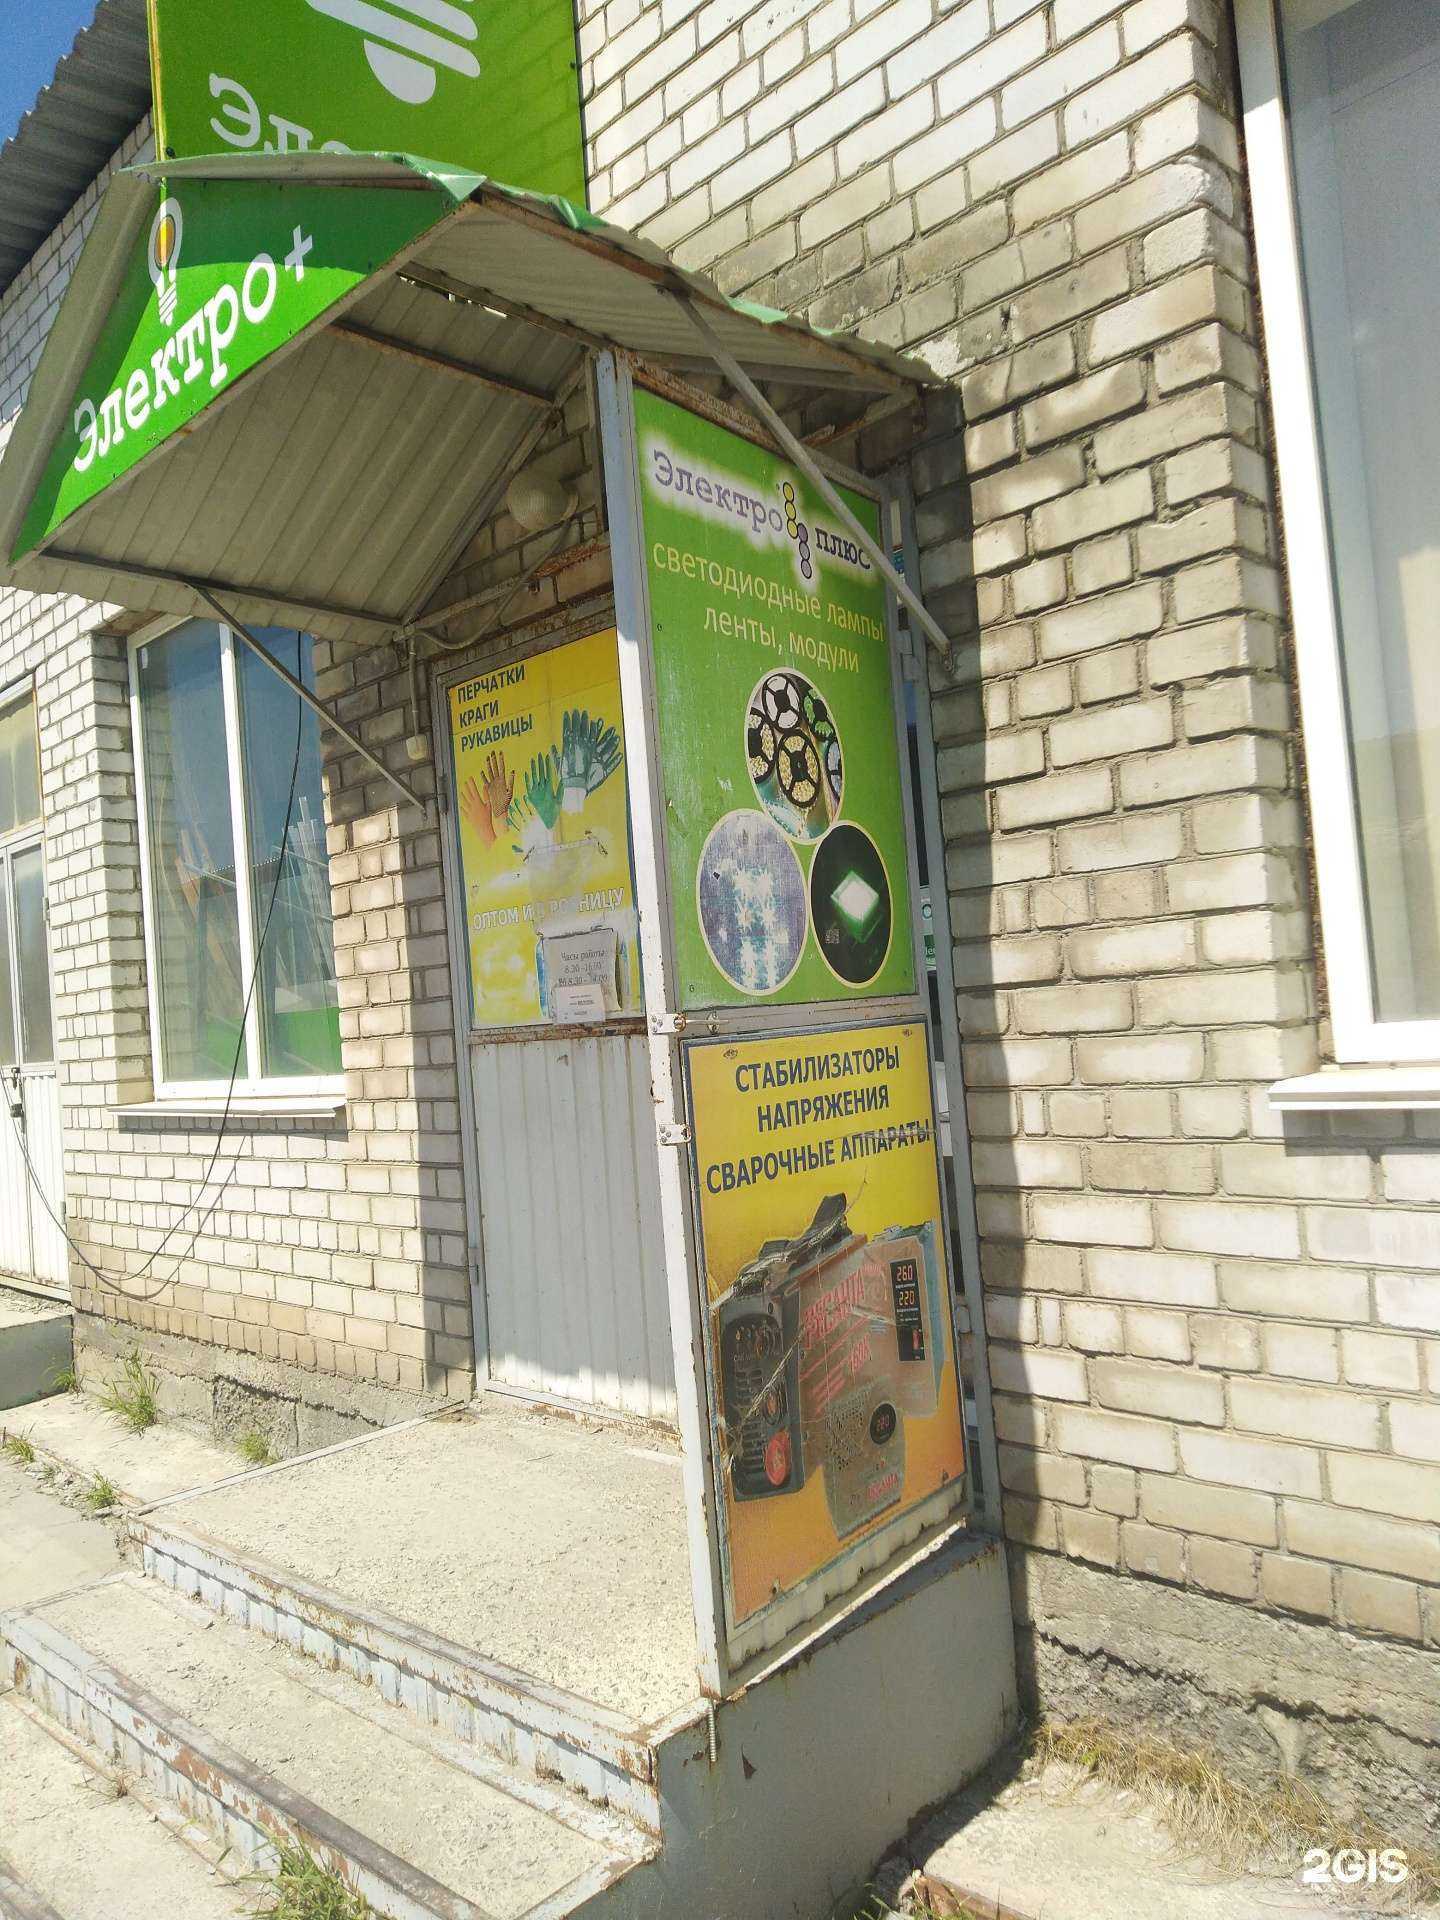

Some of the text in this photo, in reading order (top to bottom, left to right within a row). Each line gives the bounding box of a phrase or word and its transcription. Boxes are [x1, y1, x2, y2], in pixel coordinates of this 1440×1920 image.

[209, 73, 352, 154] Эл
[815, 527, 871, 570] плюс
[704, 608, 859, 673] ленты, модули
[457, 664, 526, 704] ПЕРЧАТКИ
[459, 700, 499, 728] КРАГИ
[461, 714, 533, 752] РУКАВИЦЫ
[472, 907, 519, 930] ОПТОМ
[736, 1045, 900, 1092] СТАБИЛИЗАТОРЫ
[757, 1085, 890, 1132] НАПРЯЖЕНИЯ
[706, 1119, 930, 1194] СВАРОЧНЫЕ АППАРАТЫ
